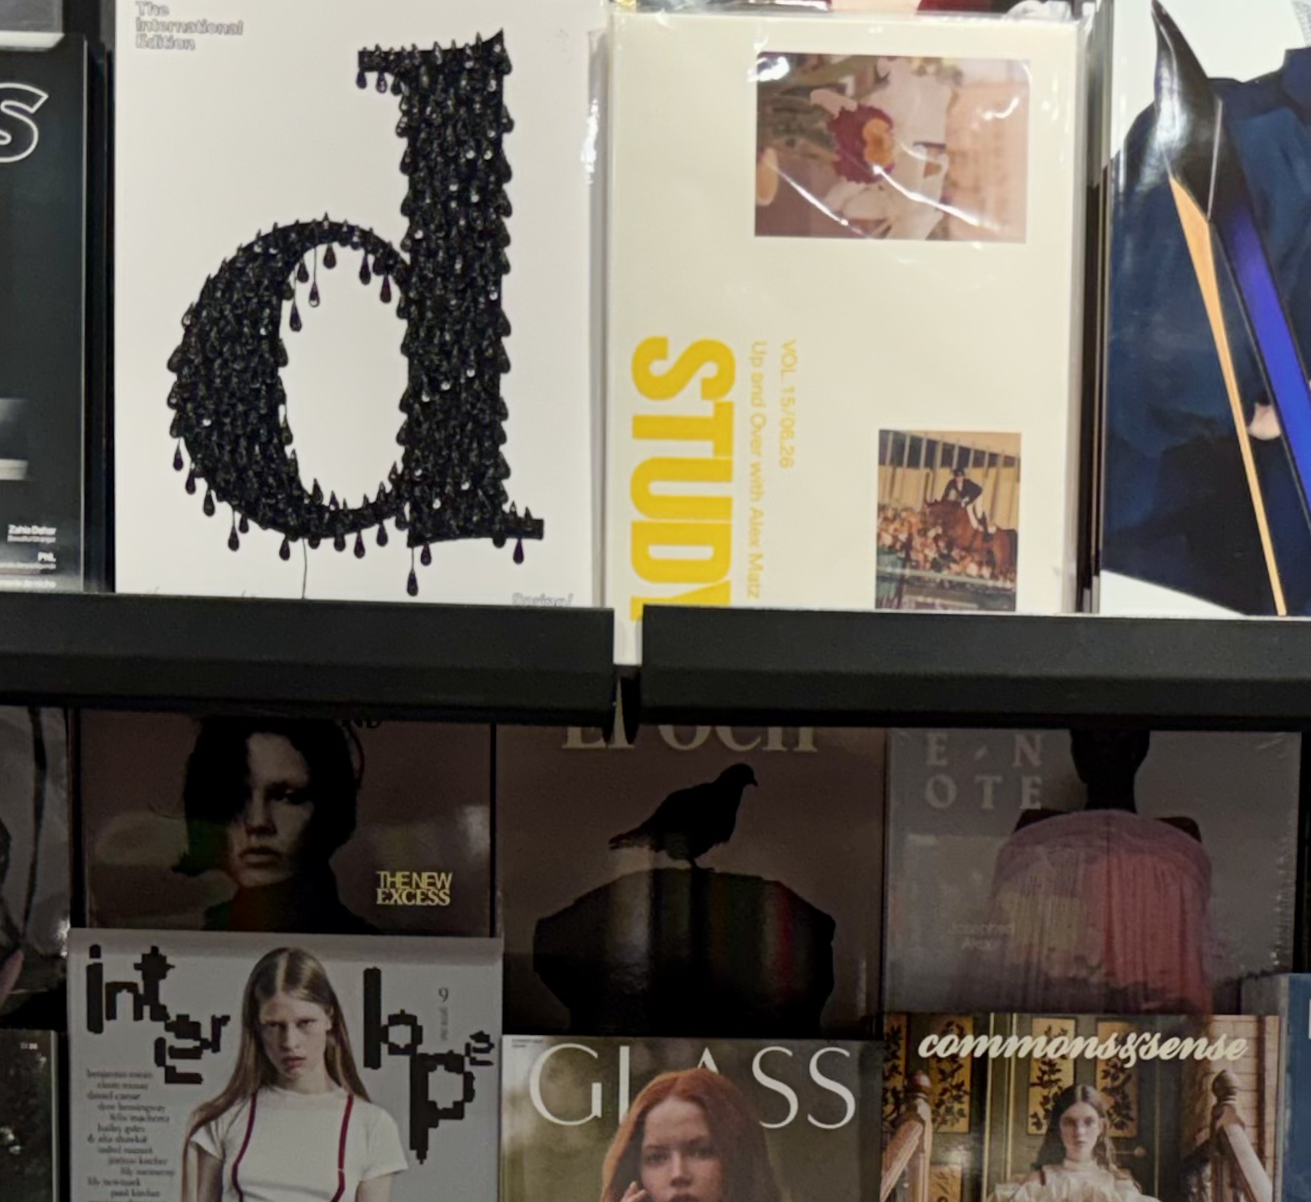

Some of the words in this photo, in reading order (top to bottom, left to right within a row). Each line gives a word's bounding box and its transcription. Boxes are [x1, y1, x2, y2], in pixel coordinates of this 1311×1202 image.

[376, 870, 410, 889] THE
[410, 871, 453, 889] NEW
[376, 888, 451, 906] EXCESS
[438, 986, 449, 1003] 9
[529, 1042, 857, 1130] GLSS
